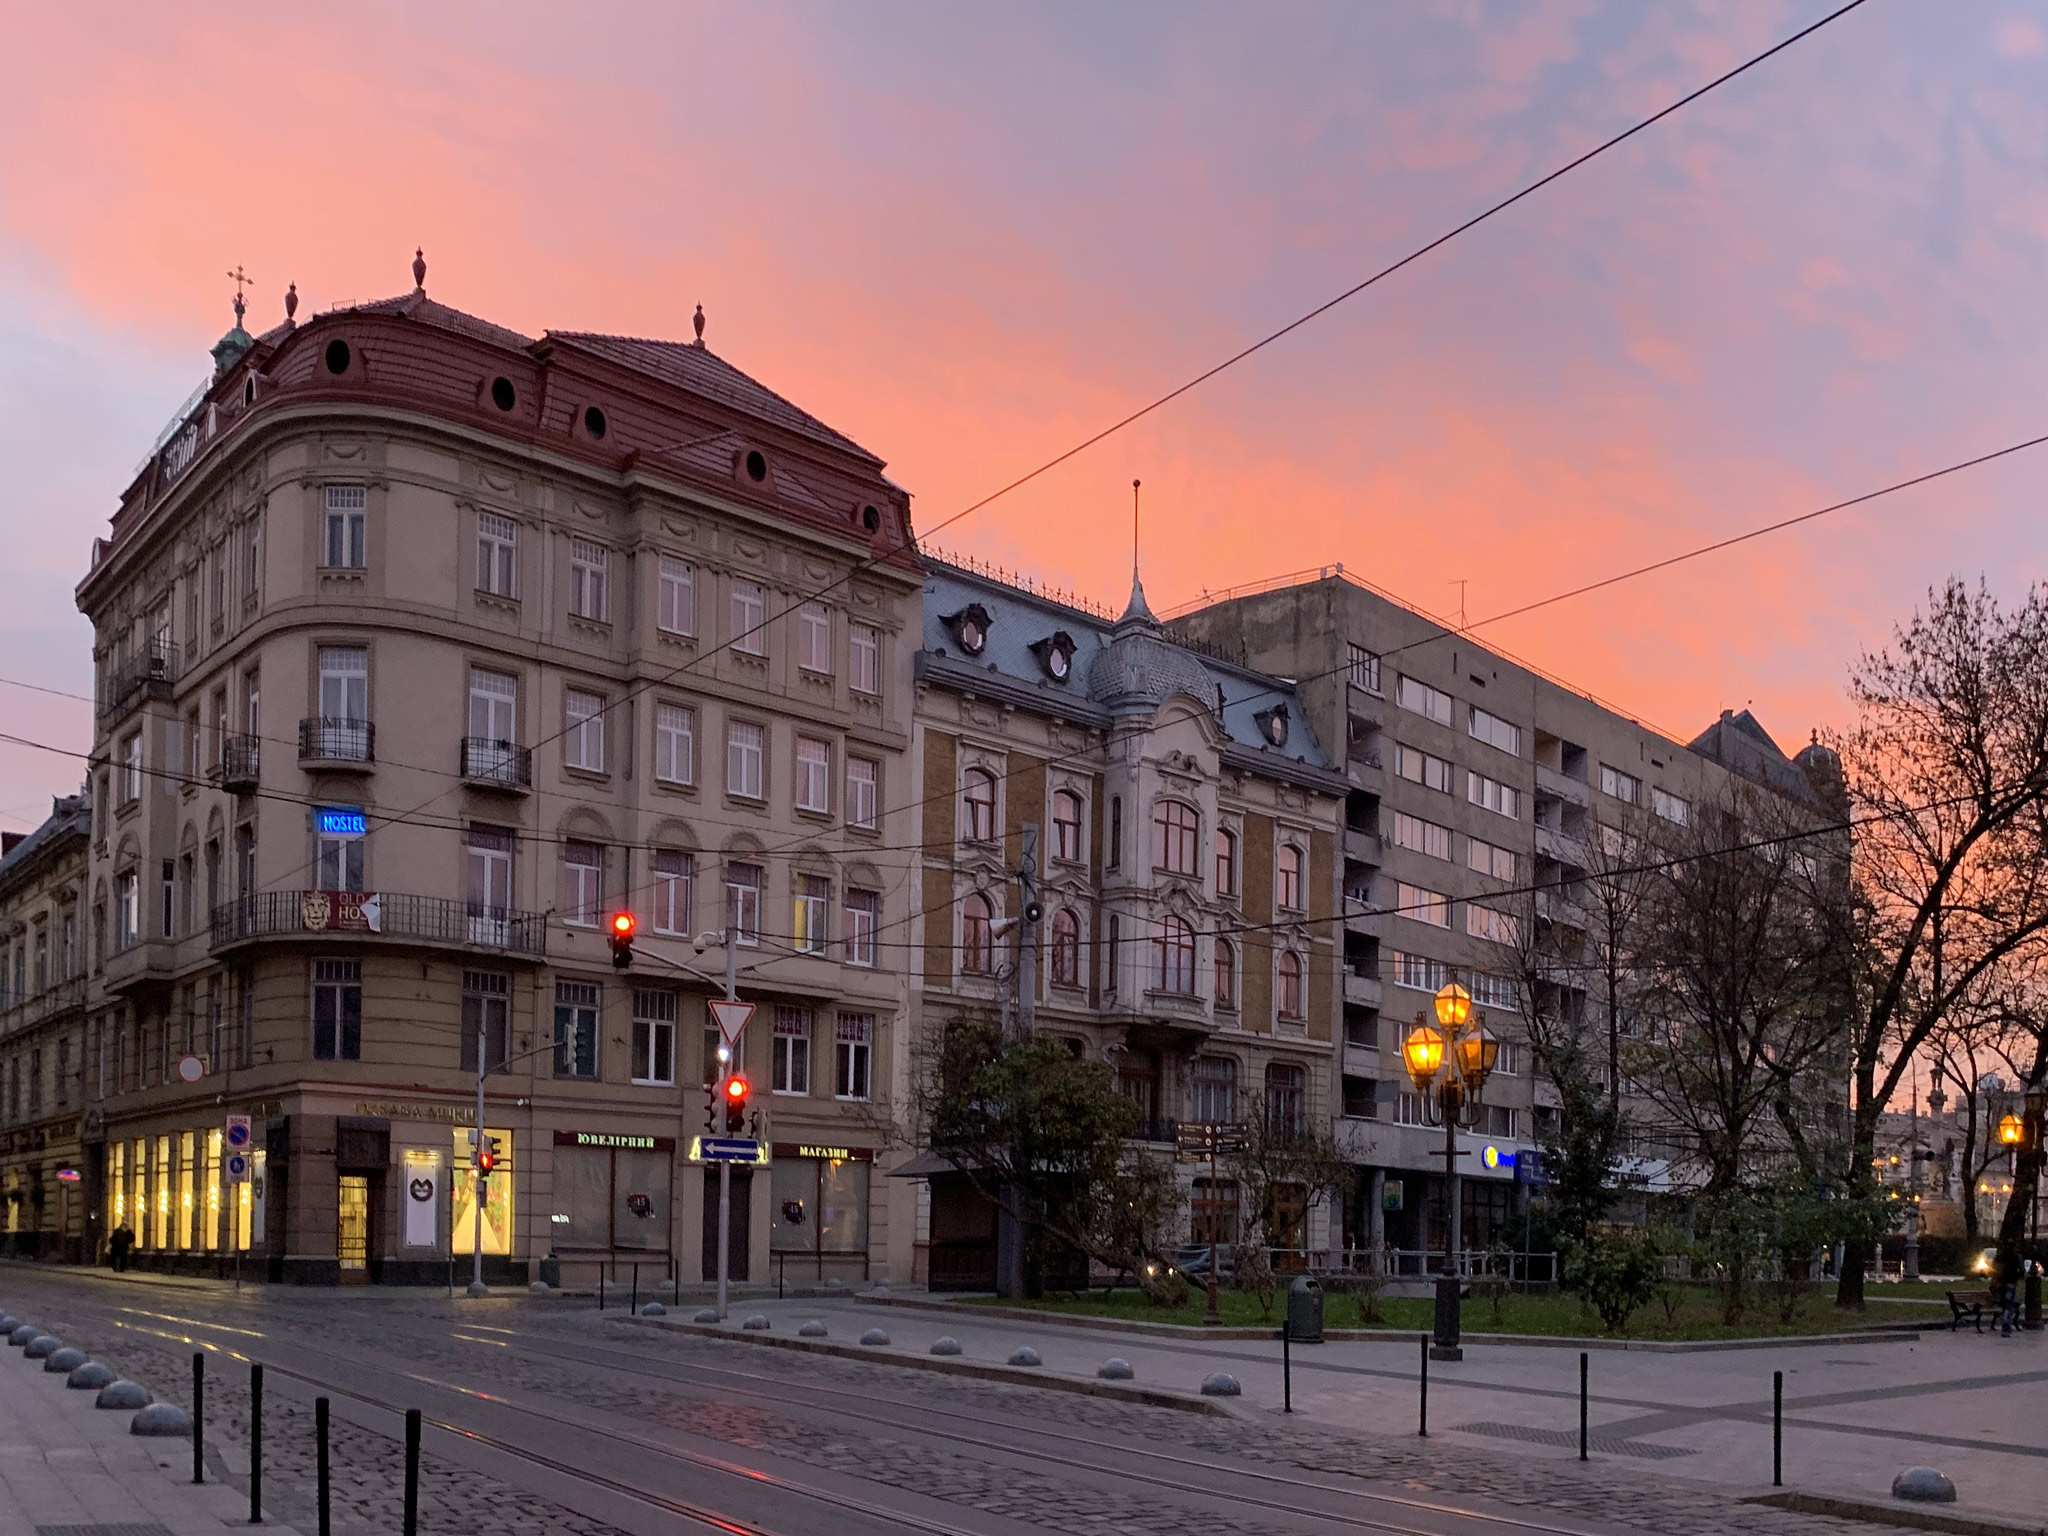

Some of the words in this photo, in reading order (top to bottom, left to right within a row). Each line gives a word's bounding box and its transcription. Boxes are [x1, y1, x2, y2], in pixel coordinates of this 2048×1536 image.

[323, 815, 366, 832] HOSTEL
[339, 893, 365, 905] OLD
[339, 906, 368, 920] HO
[577, 1132, 655, 1148] ЮВЕЛІРНИЙ
[799, 1145, 848, 1159] МАГАЗИН
